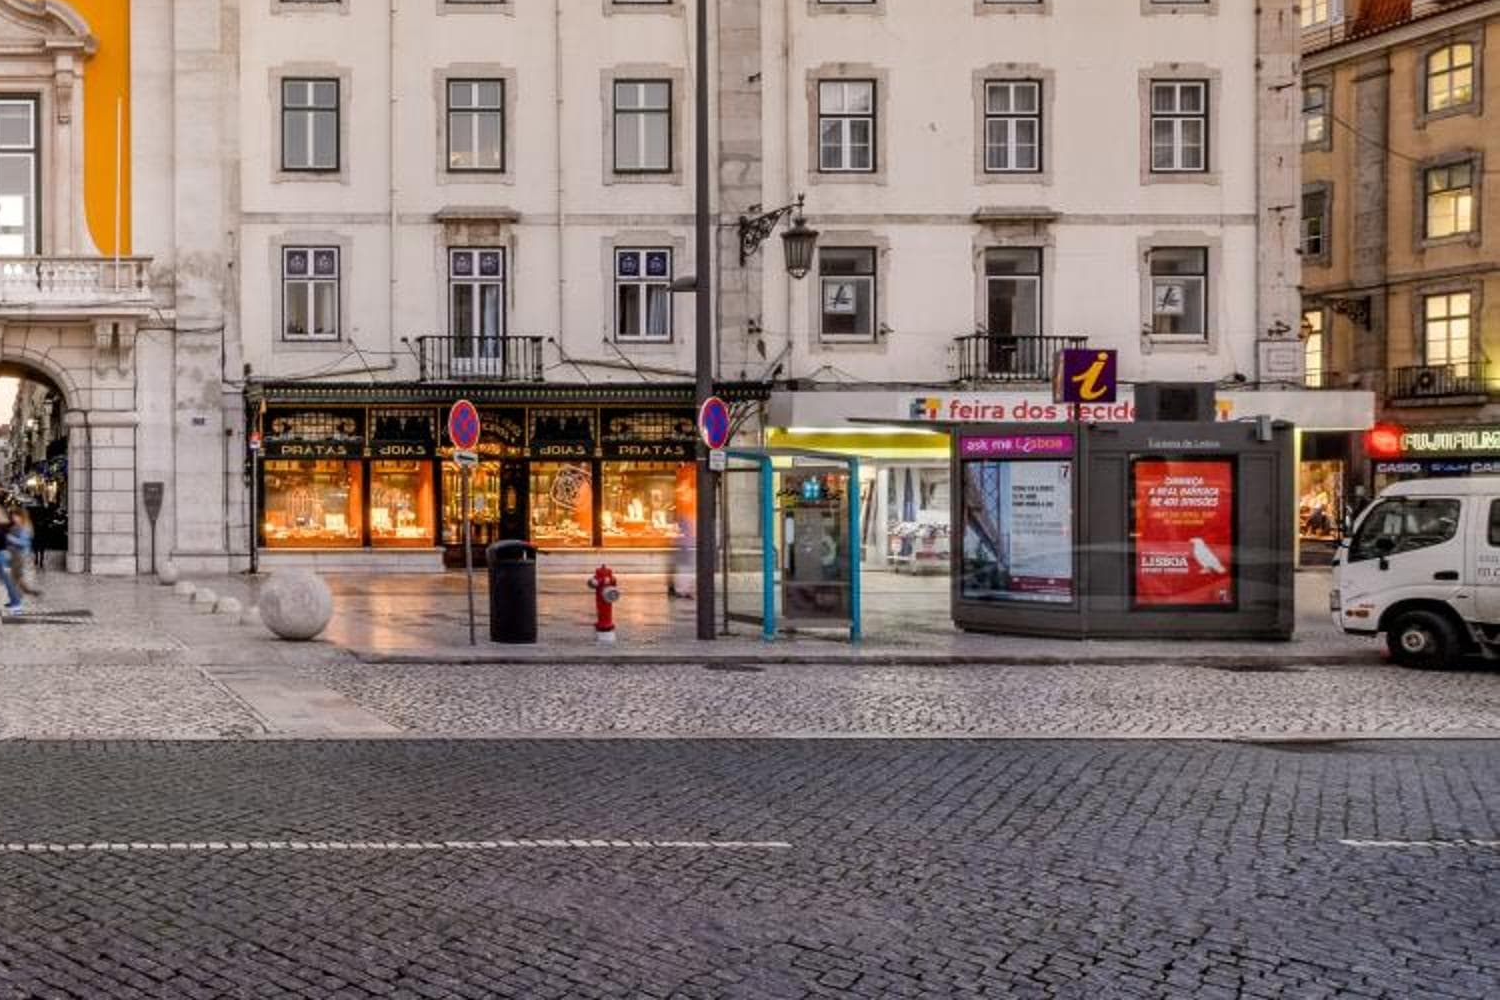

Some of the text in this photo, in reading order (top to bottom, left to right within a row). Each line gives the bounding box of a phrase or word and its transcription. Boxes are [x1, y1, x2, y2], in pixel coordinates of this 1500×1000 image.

[949, 399, 1005, 420] feira
[1012, 399, 1057, 420] dos
[539, 445, 585, 455] JOIAS
[618, 445, 685, 455] PRATAS
[966, 440, 988, 451] ask
[991, 440, 1012, 450] me
[281, 446, 348, 456] PRATAS
[380, 446, 427, 456] JOIAS
[1377, 463, 1421, 473] CASIO
